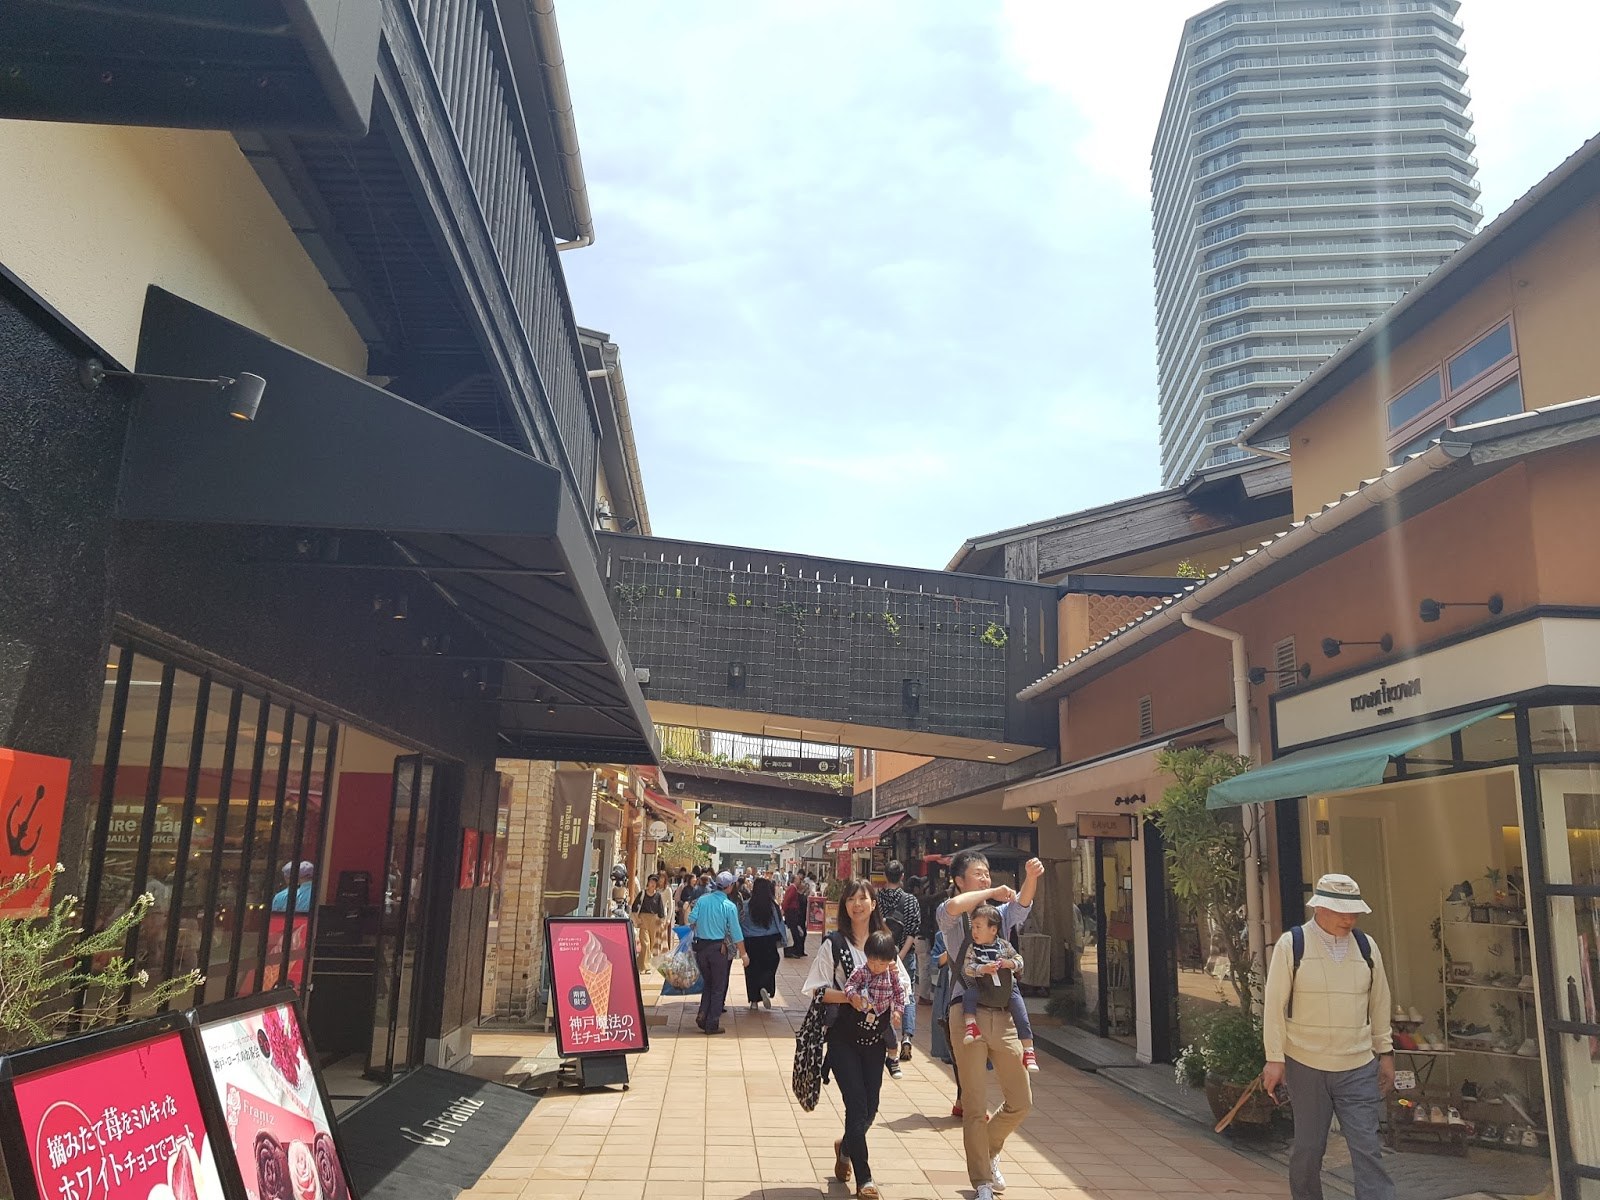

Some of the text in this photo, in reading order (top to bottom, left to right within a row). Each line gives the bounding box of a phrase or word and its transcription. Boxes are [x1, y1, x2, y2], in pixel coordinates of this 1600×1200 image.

[568, 1014, 634, 1032] 神戸魔法の
[571, 1029, 636, 1045] 生チョコソフト
[243, 1099, 275, 1125] Frantz
[422, 1096, 485, 1134] Frantz
[58, 1124, 195, 1200] ホワイトチョコでコート
